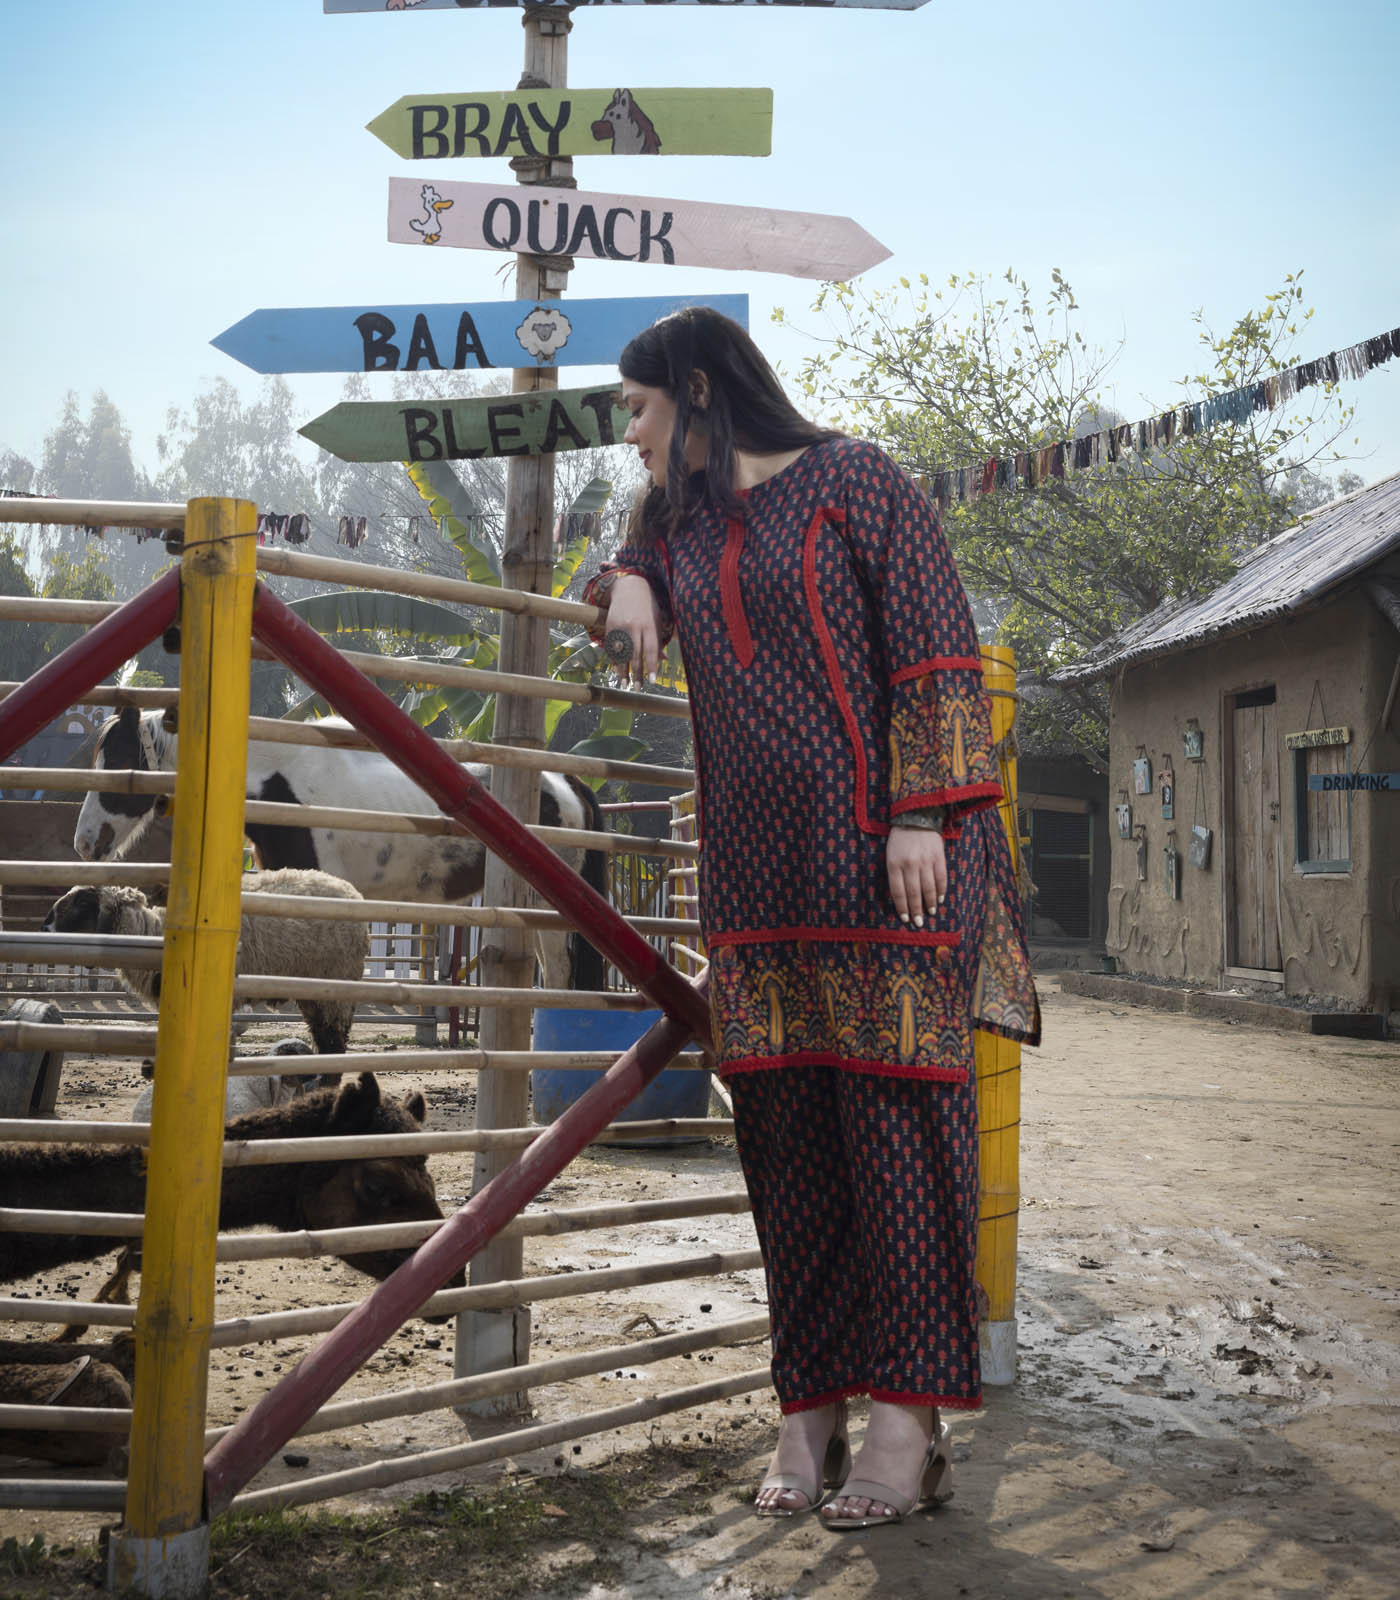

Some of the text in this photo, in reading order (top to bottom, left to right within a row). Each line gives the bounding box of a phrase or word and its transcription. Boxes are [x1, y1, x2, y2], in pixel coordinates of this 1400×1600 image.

[406, 101, 571, 158] BRAY
[482, 197, 675, 265] QUACK
[353, 310, 496, 371] BAA
[399, 390, 618, 462] BLEAT
[1323, 775, 1390, 791] DRINKING
